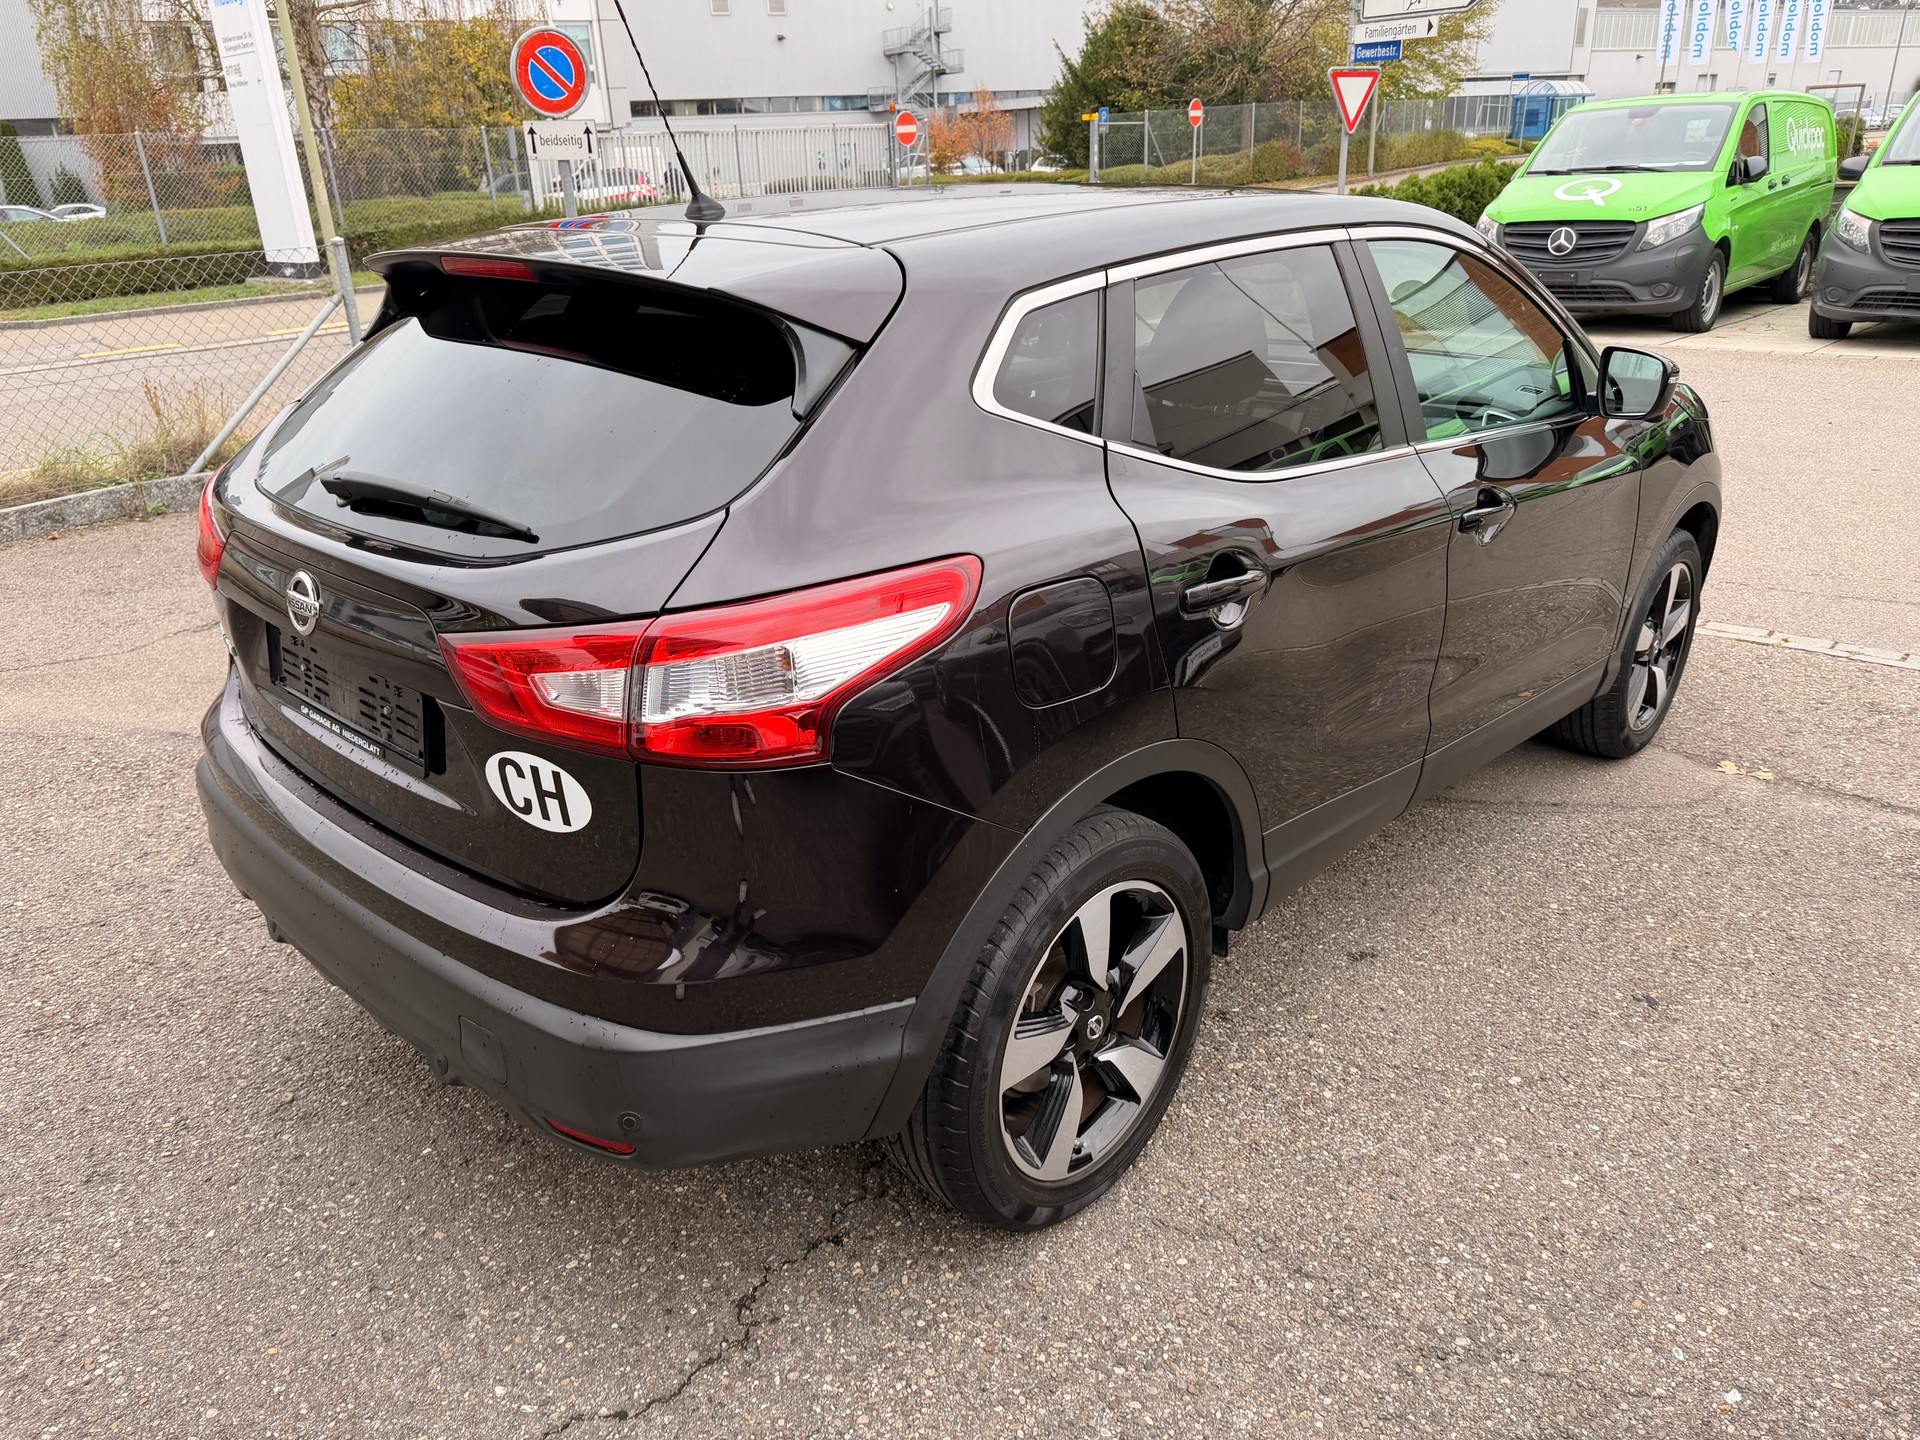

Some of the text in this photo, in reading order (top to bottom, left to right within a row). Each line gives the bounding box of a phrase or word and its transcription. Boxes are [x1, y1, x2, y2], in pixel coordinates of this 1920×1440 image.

[1356, 45, 1399, 59] Gewerbestr.
[1364, 24, 1416, 39] Familiengärten
[1660, 0, 1679, 59] olidom
[1692, 0, 1712, 58] olidom
[1754, 0, 1770, 57] olidom
[1780, 0, 1799, 57] olidom
[1809, 0, 1825, 56] olidom
[539, 133, 583, 149] beidseitig
[300, 705, 381, 756] GP GARAGE AG NIEDERGLATT
[498, 757, 572, 827] CH
